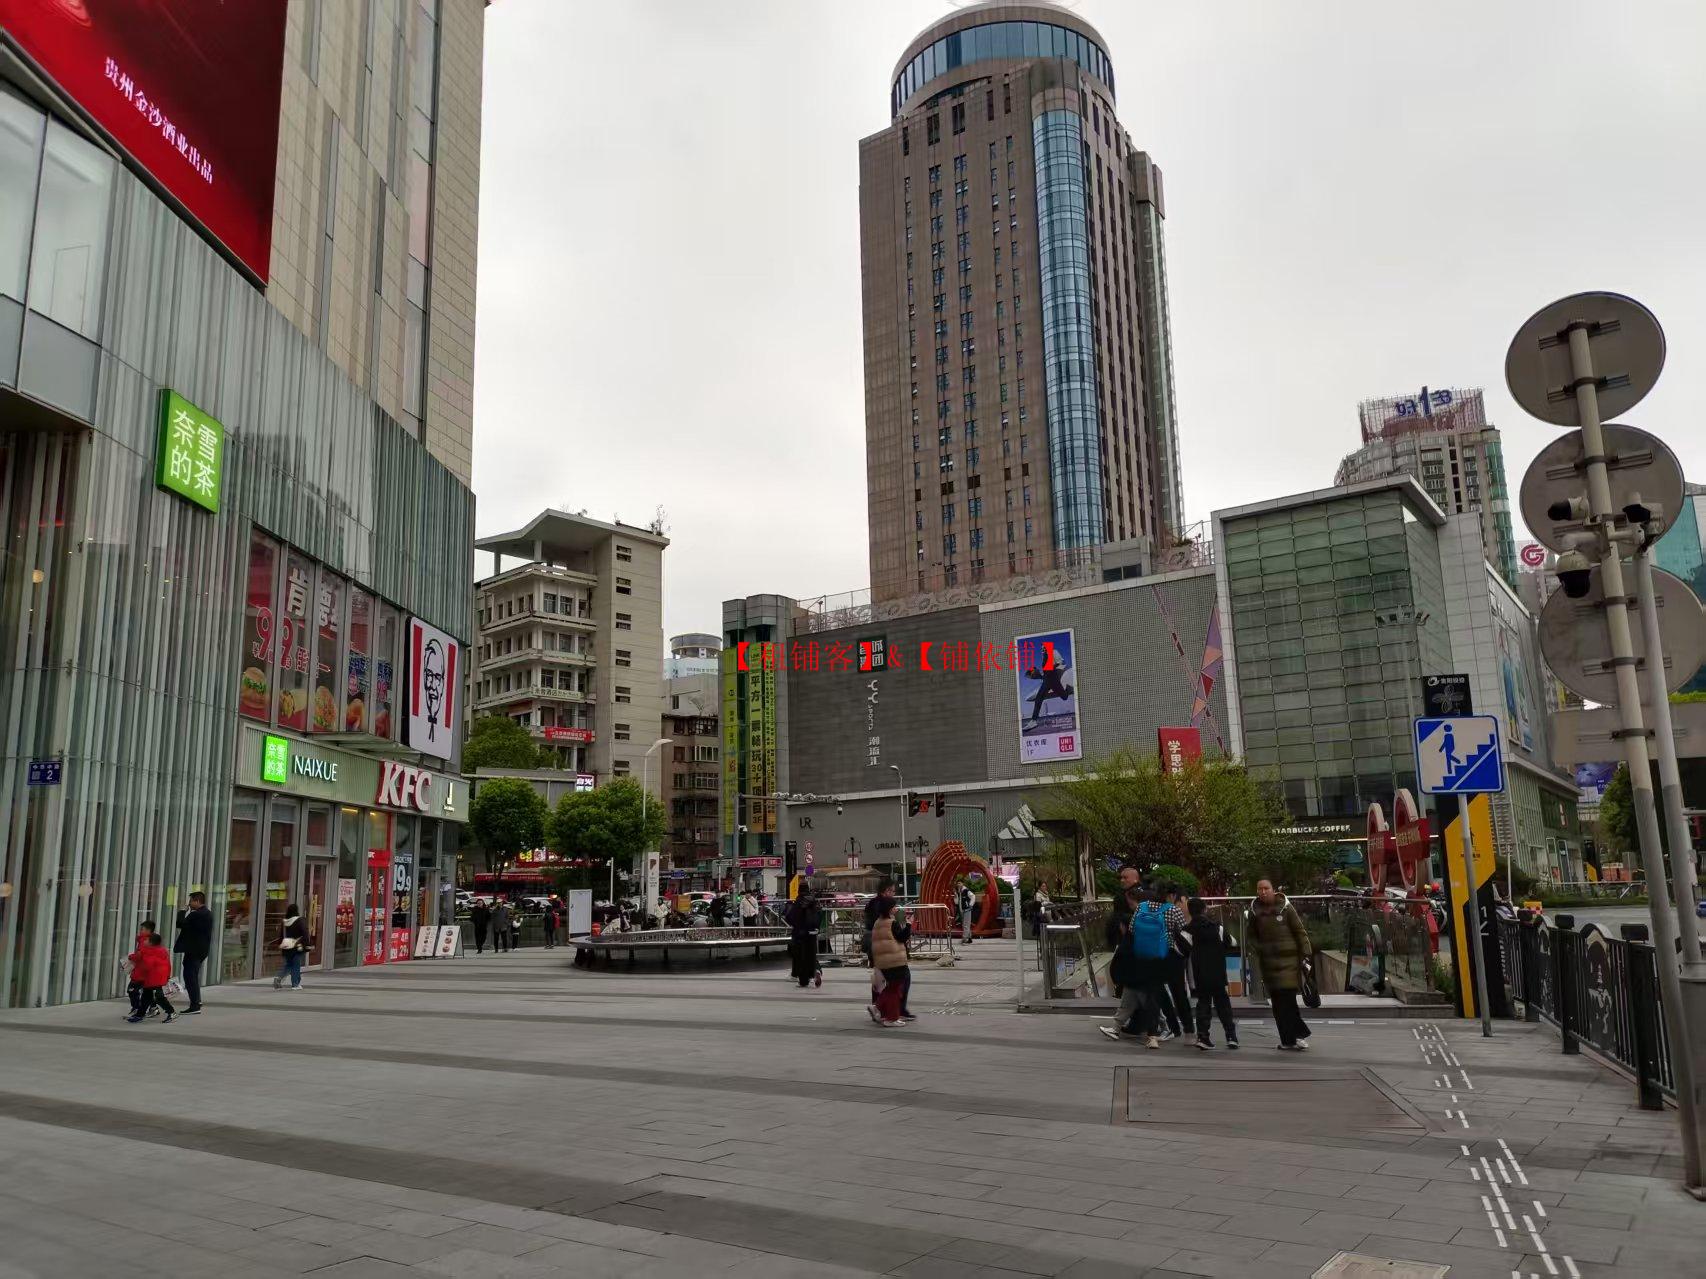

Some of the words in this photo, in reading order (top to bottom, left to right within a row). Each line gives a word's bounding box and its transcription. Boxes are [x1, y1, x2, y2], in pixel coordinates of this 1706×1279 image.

[104, 57, 213, 184] 贵州金沙酒业出品
[1026, 739, 1047, 747] 优衣库
[294, 754, 338, 782] NAIXUE
[378, 761, 432, 811] KFC
[799, 816, 814, 830] UR
[875, 841, 900, 850] URBAN
